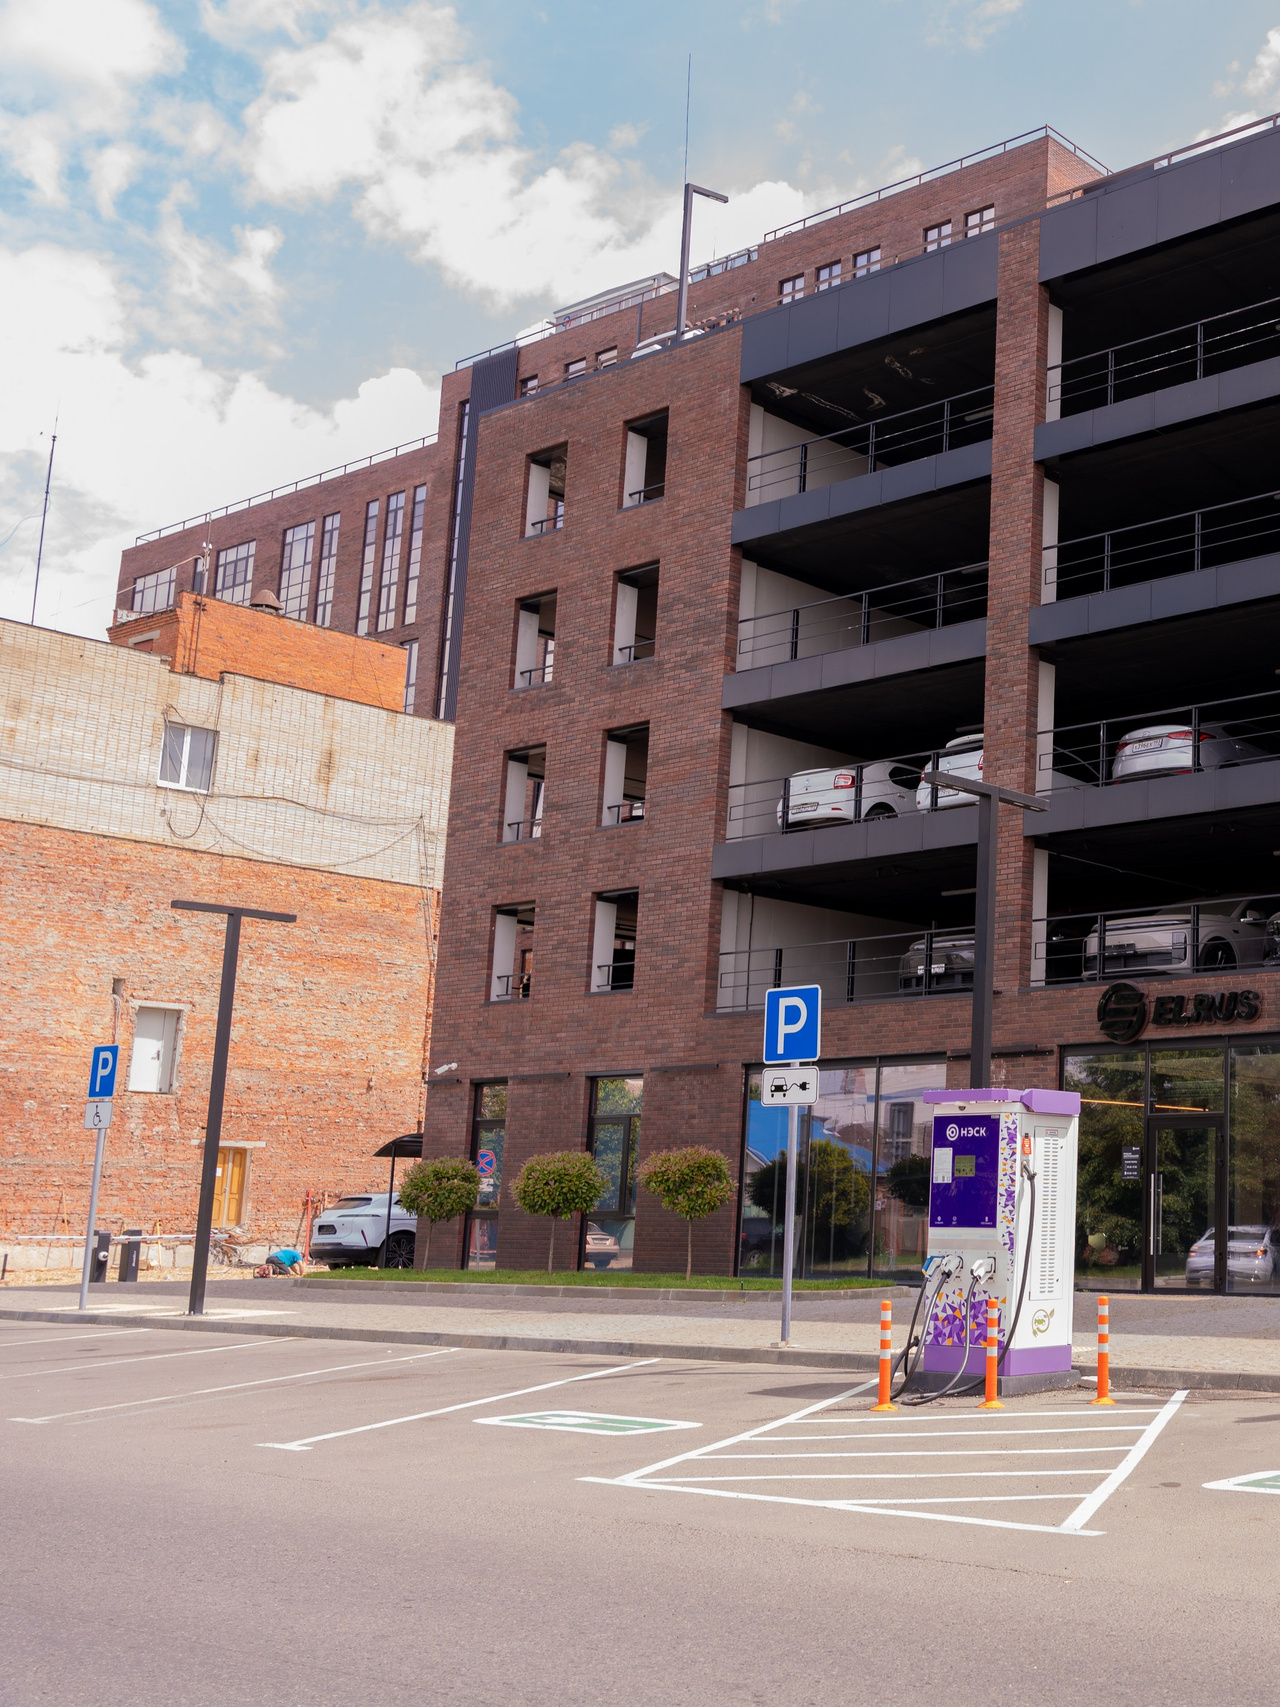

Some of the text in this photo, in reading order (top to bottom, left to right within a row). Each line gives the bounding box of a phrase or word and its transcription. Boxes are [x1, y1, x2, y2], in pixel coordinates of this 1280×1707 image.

[777, 996, 808, 1055] P
[1151, 989, 1261, 1027] ELRUS
[95, 1050, 113, 1093] P
[960, 1126, 987, 1137] НЭСК
